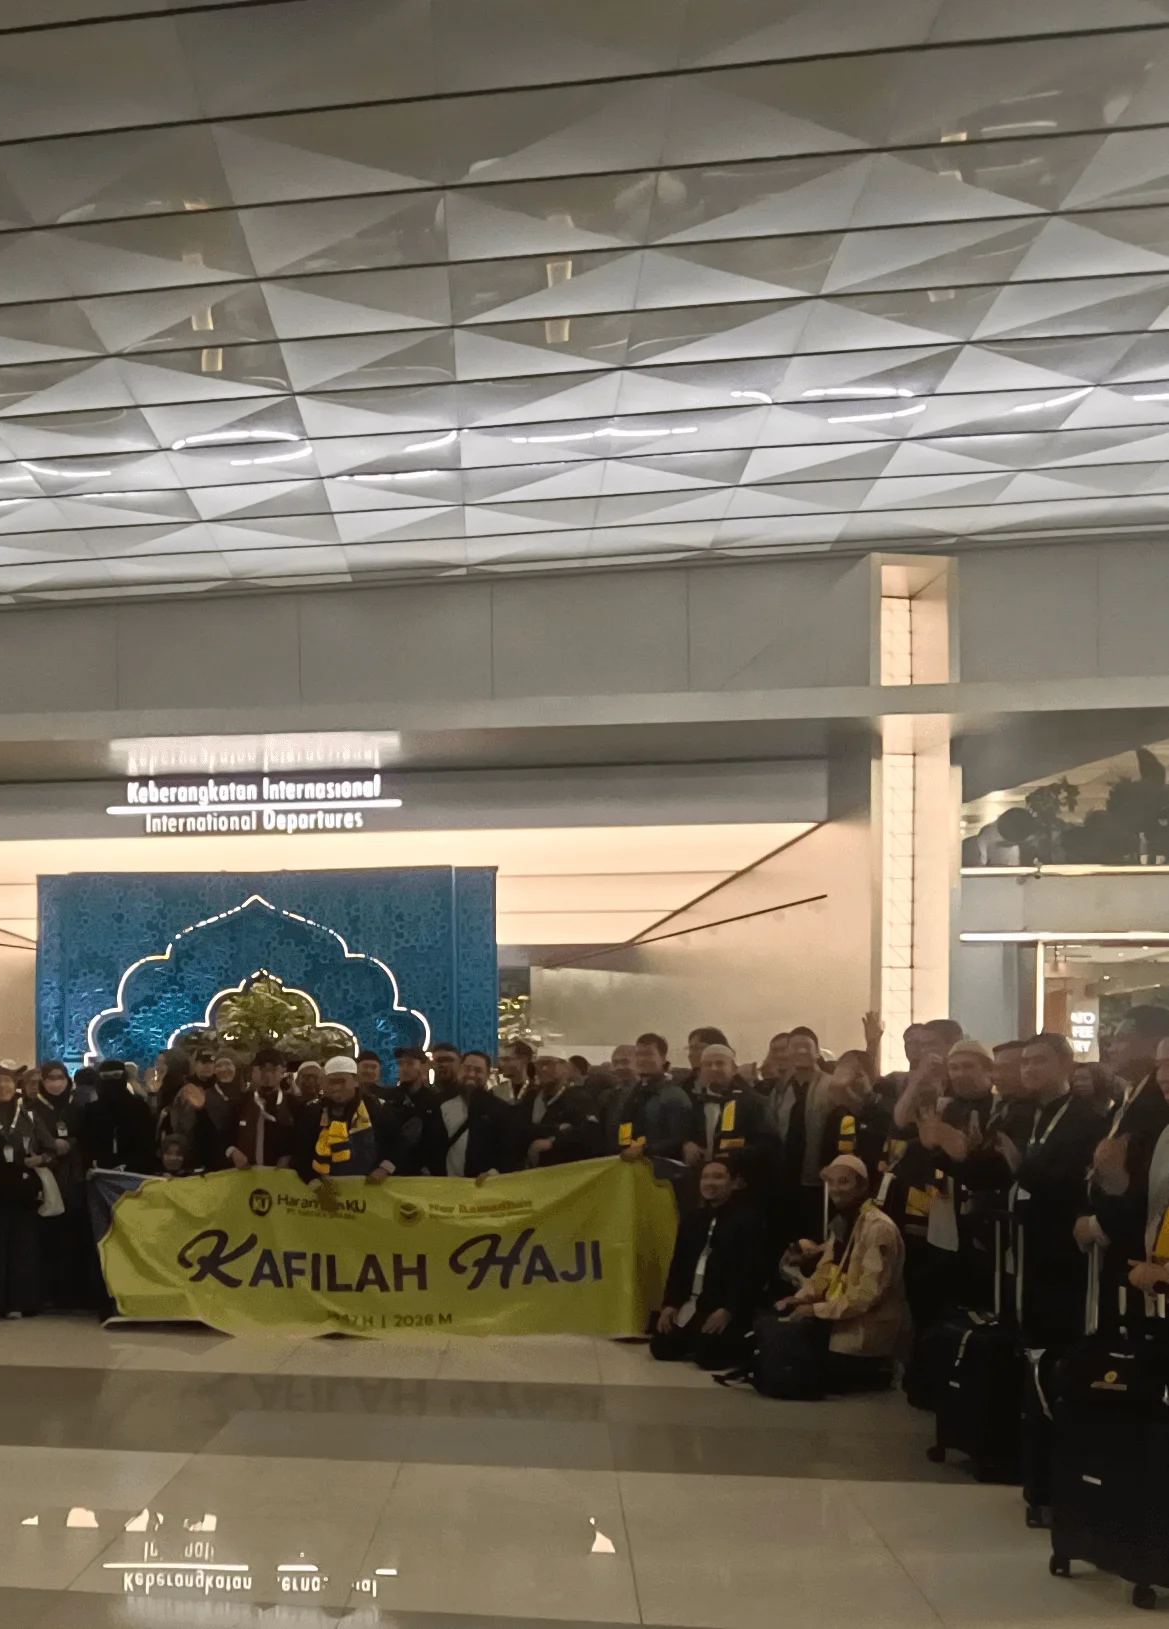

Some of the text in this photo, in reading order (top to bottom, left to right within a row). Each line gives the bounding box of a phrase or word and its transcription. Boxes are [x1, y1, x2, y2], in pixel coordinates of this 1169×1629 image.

[127, 774, 381, 806] Keberangkatan Internasional
[145, 808, 364, 834] International Departures
[276, 1193, 367, 1214] HaramnKU
[177, 1227, 603, 1292] KAFILAH HAJI
